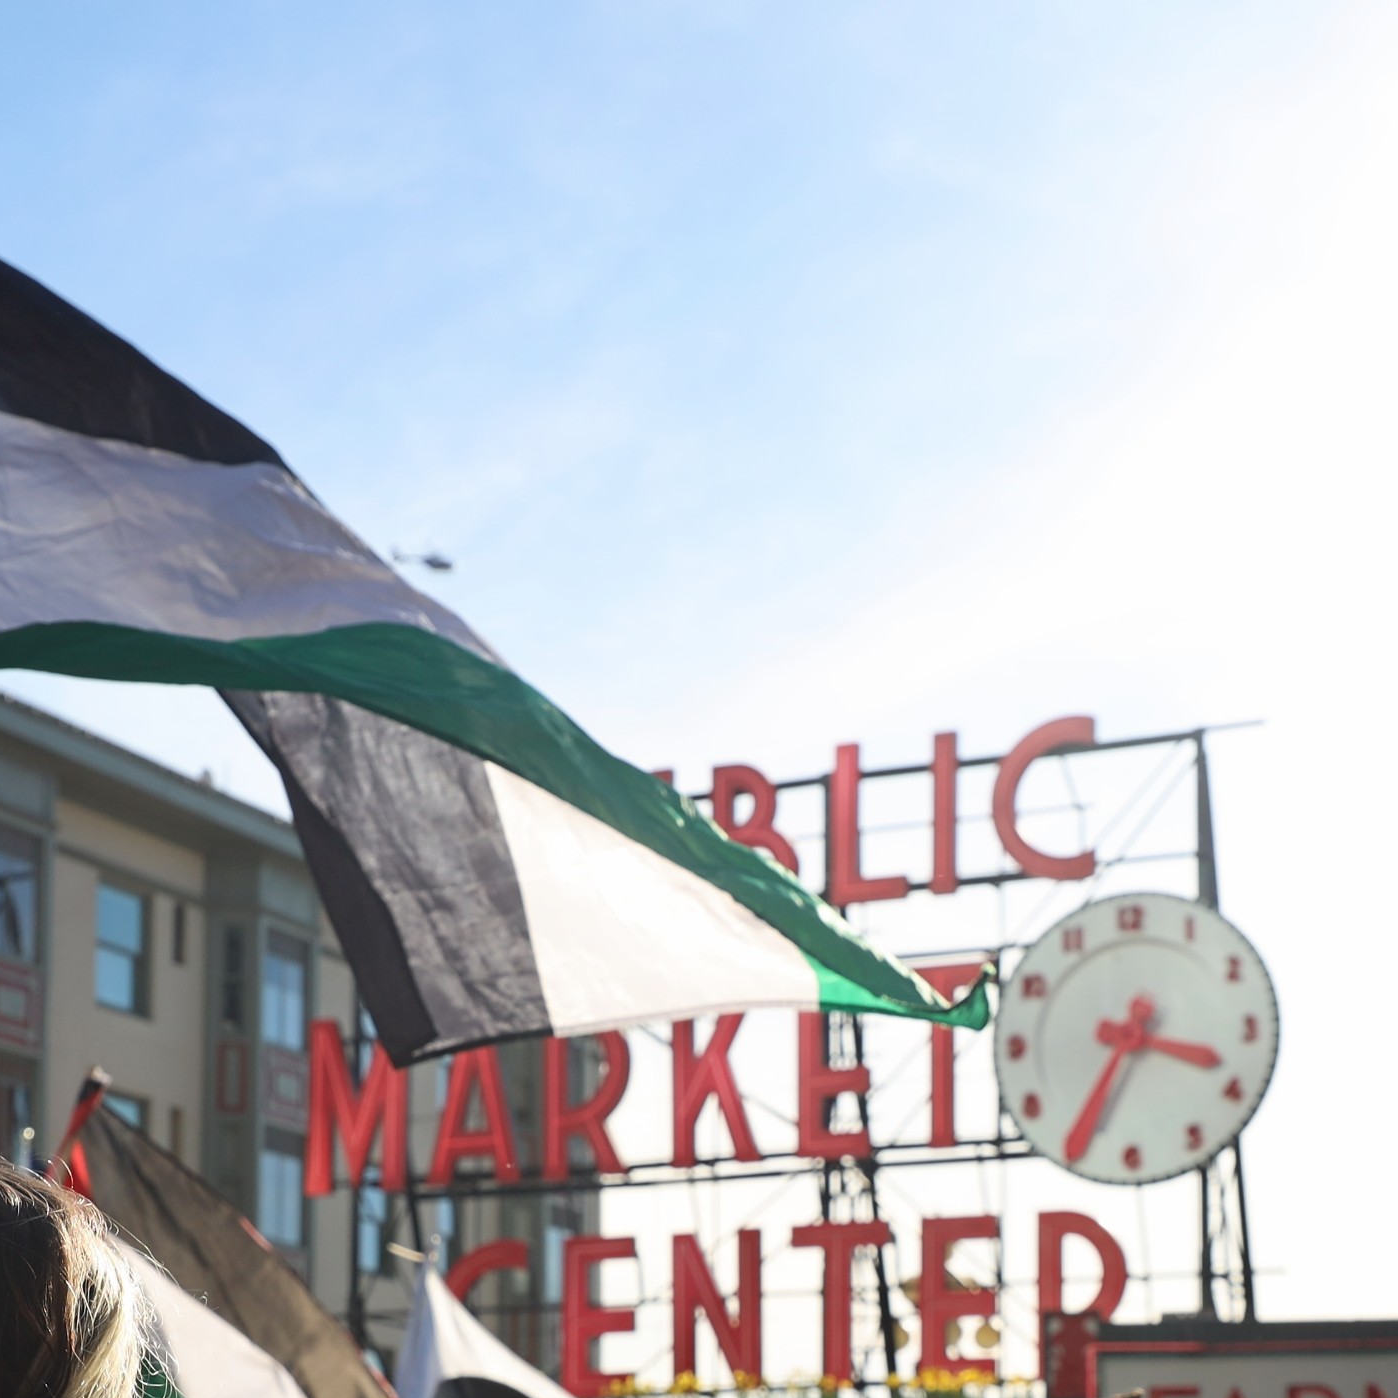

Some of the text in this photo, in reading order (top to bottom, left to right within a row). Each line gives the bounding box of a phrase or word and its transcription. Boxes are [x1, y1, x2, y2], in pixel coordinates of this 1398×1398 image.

[653, 716, 1096, 906] BLIC
[1117, 905, 1145, 932] 12
[1225, 955, 1241, 983] 2
[305, 960, 1000, 1197] MARKET
[1223, 1078, 1243, 1102] 4
